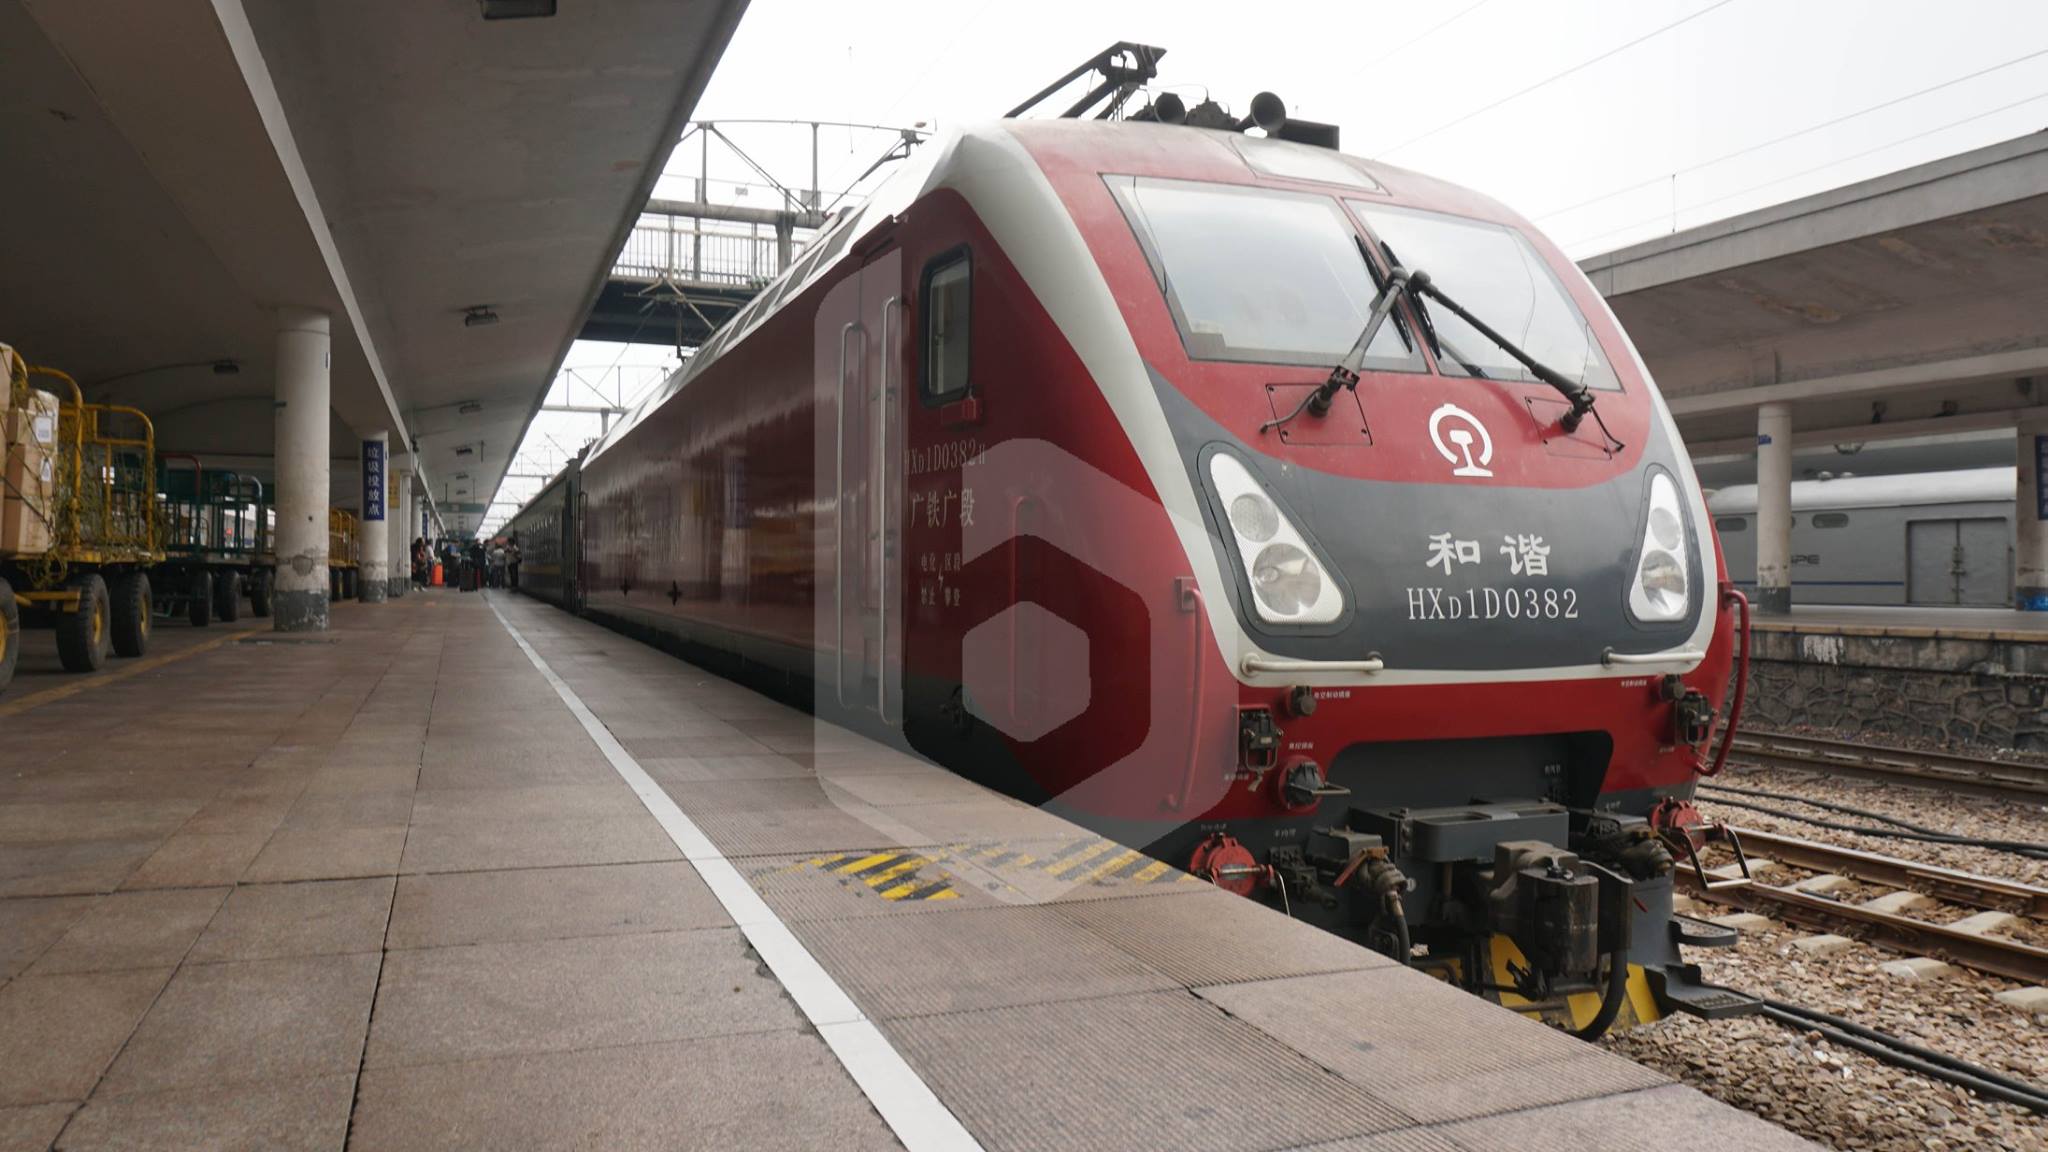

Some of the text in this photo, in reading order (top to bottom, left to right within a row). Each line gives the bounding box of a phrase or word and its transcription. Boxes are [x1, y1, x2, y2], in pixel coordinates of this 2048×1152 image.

[910, 487, 976, 529] 广铁广段
[1425, 531, 1551, 576] 和谐
